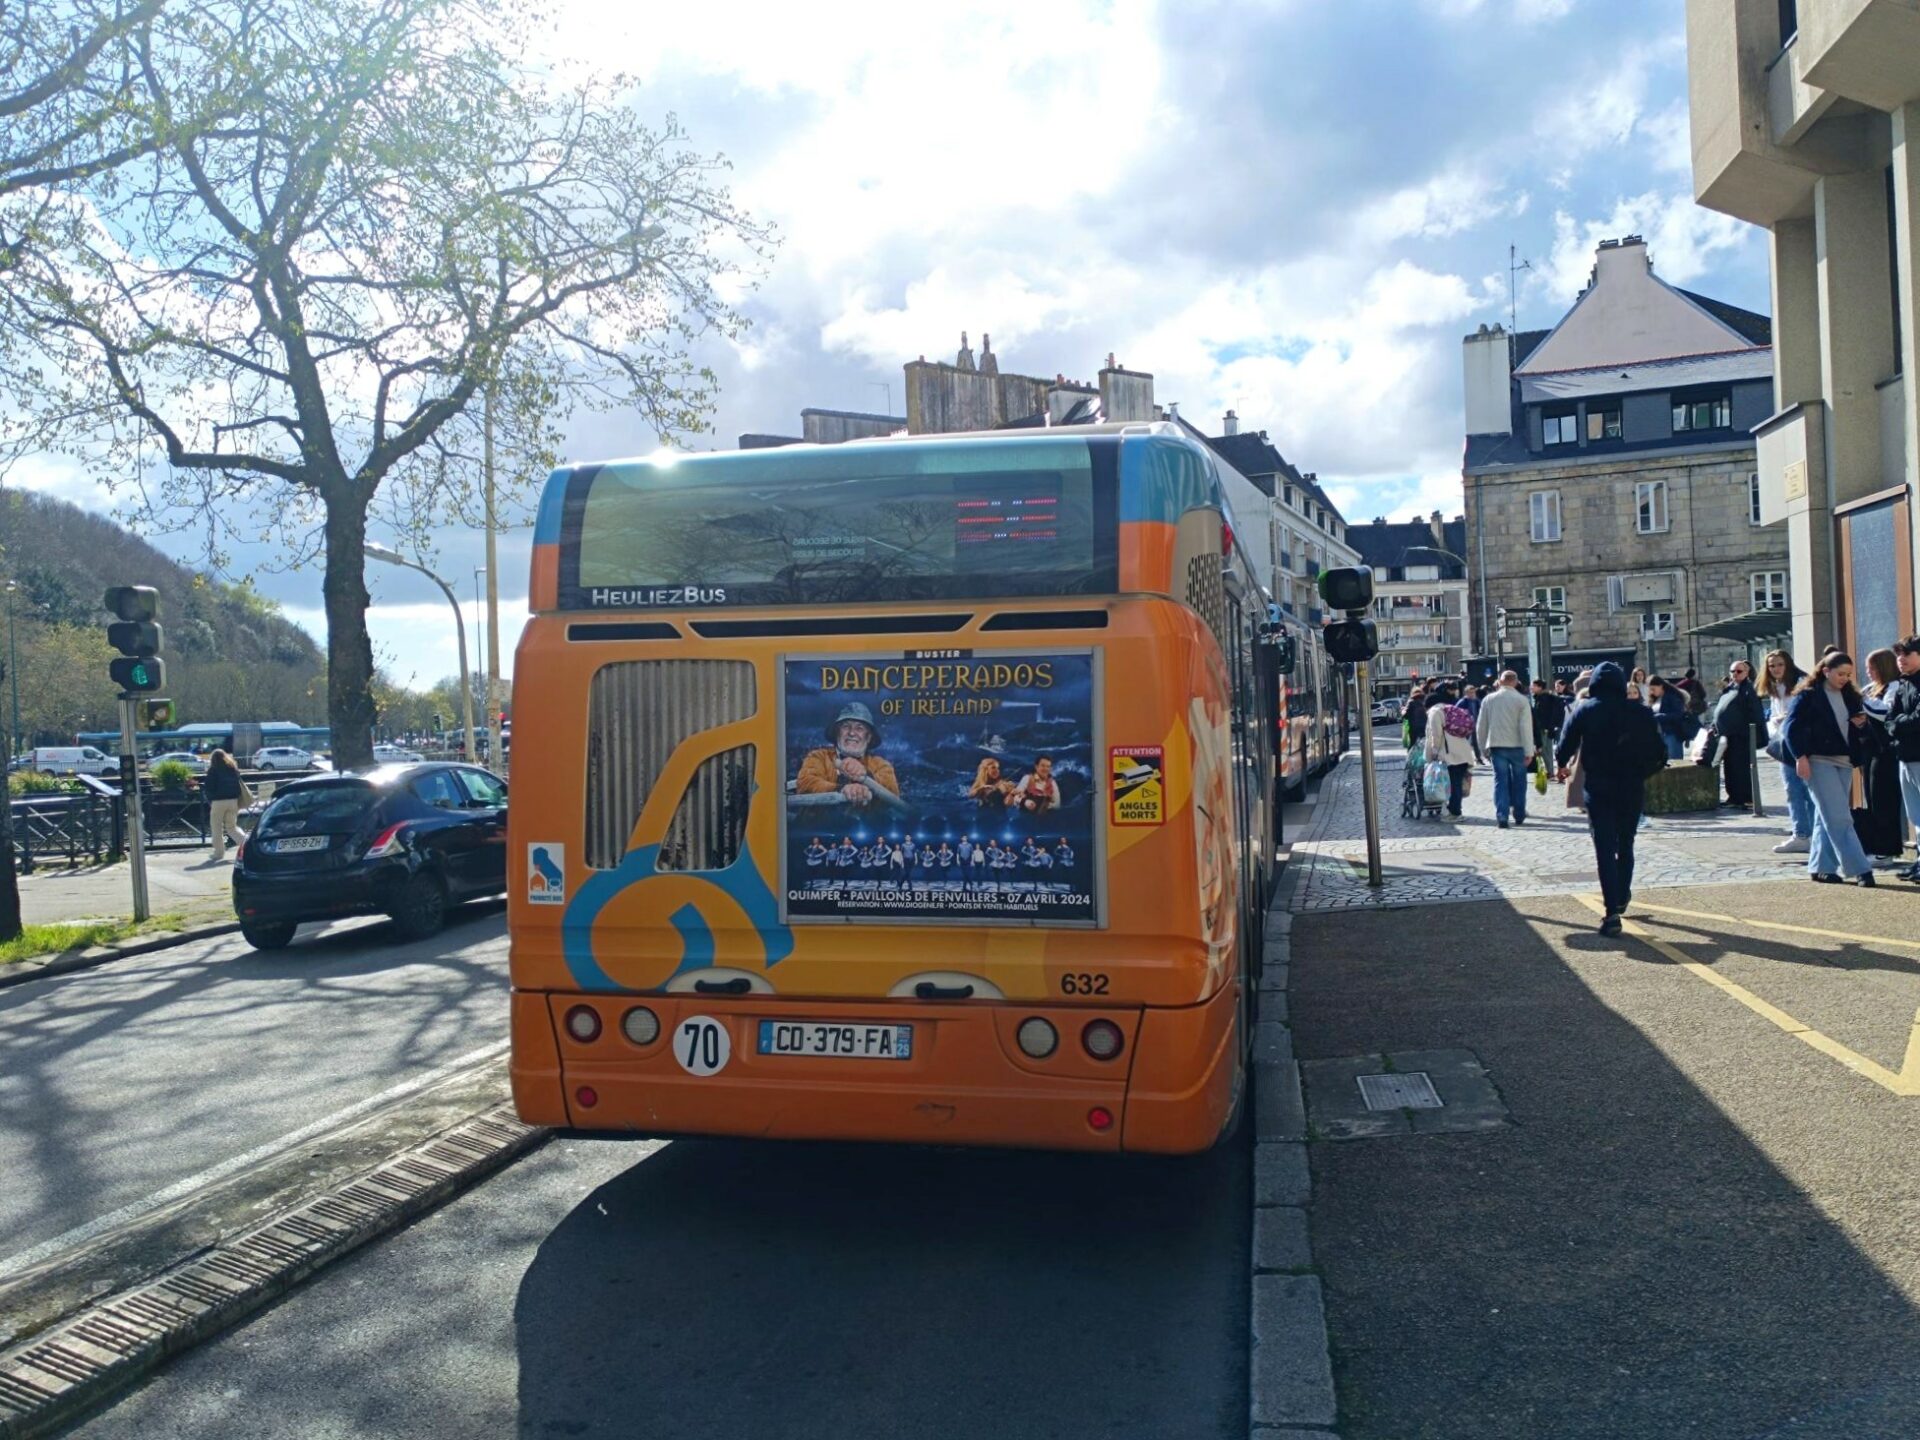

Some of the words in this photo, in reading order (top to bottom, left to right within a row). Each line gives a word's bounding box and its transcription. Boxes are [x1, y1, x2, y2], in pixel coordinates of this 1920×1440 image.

[916, 649, 961, 659] BUSTER
[820, 663, 1053, 694] DANCEPERADOS
[881, 699, 904, 715] OF
[911, 698, 993, 718] IRELAND
[1113, 747, 1161, 756] ATTENTION
[1119, 802, 1157, 810] ANGLES
[1121, 811, 1156, 819] MORTS
[788, 890, 840, 901] QUIMPER
[850, 890, 912, 902] PAVILLONS
[915, 891, 928, 902] DE
[931, 892, 998, 903] PENVILLERS
[1007, 893, 1022, 903] 07
[1024, 893, 1057, 904] AVRIL
[1060, 894, 1090, 905] 2024
[1003, 902, 1038, 911] HABITUELS
[1061, 973, 1109, 995] 632
[684, 1023, 719, 1069] 70
[776, 1025, 892, 1055] CD-379-FA
